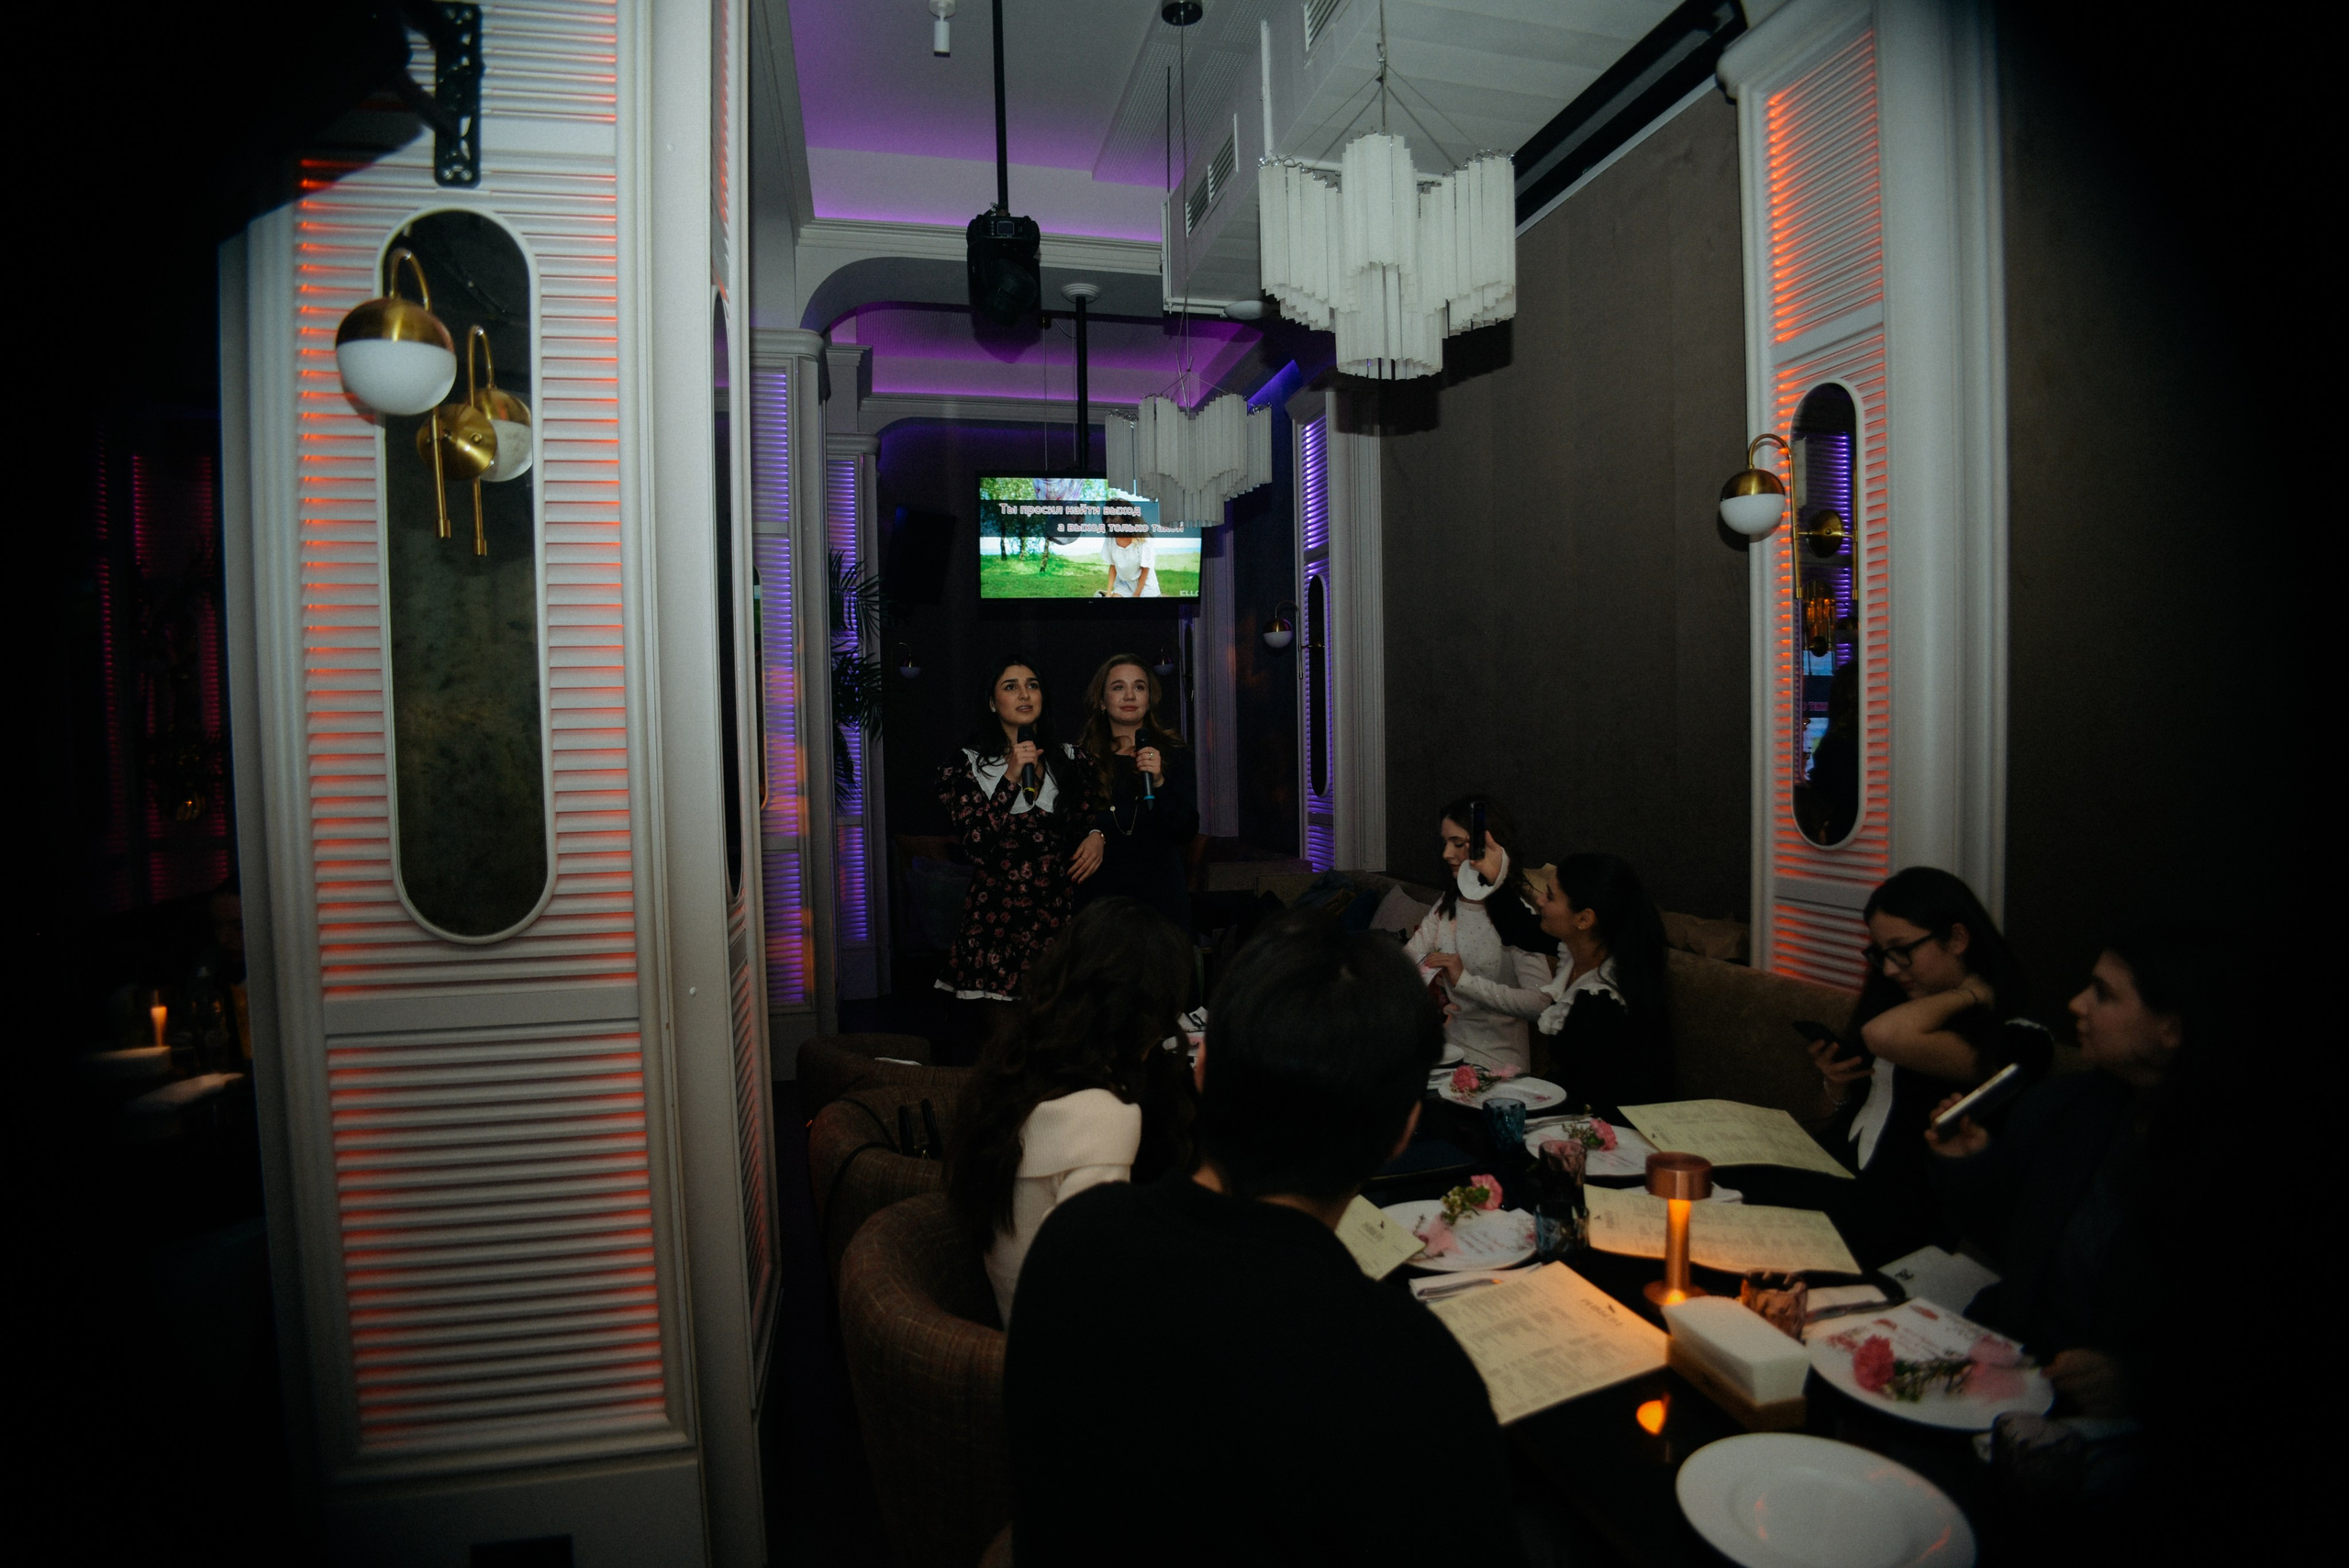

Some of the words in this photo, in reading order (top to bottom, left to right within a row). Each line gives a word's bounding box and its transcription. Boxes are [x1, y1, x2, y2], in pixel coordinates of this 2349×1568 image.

[999, 503, 1018, 515] Ты
[1019, 506, 1063, 517] просил
[1065, 503, 1101, 515] найти
[1103, 506, 1141, 517] выход
[1057, 523, 1065, 532] а
[1067, 523, 1106, 533] выход
[1108, 523, 1150, 532] только
